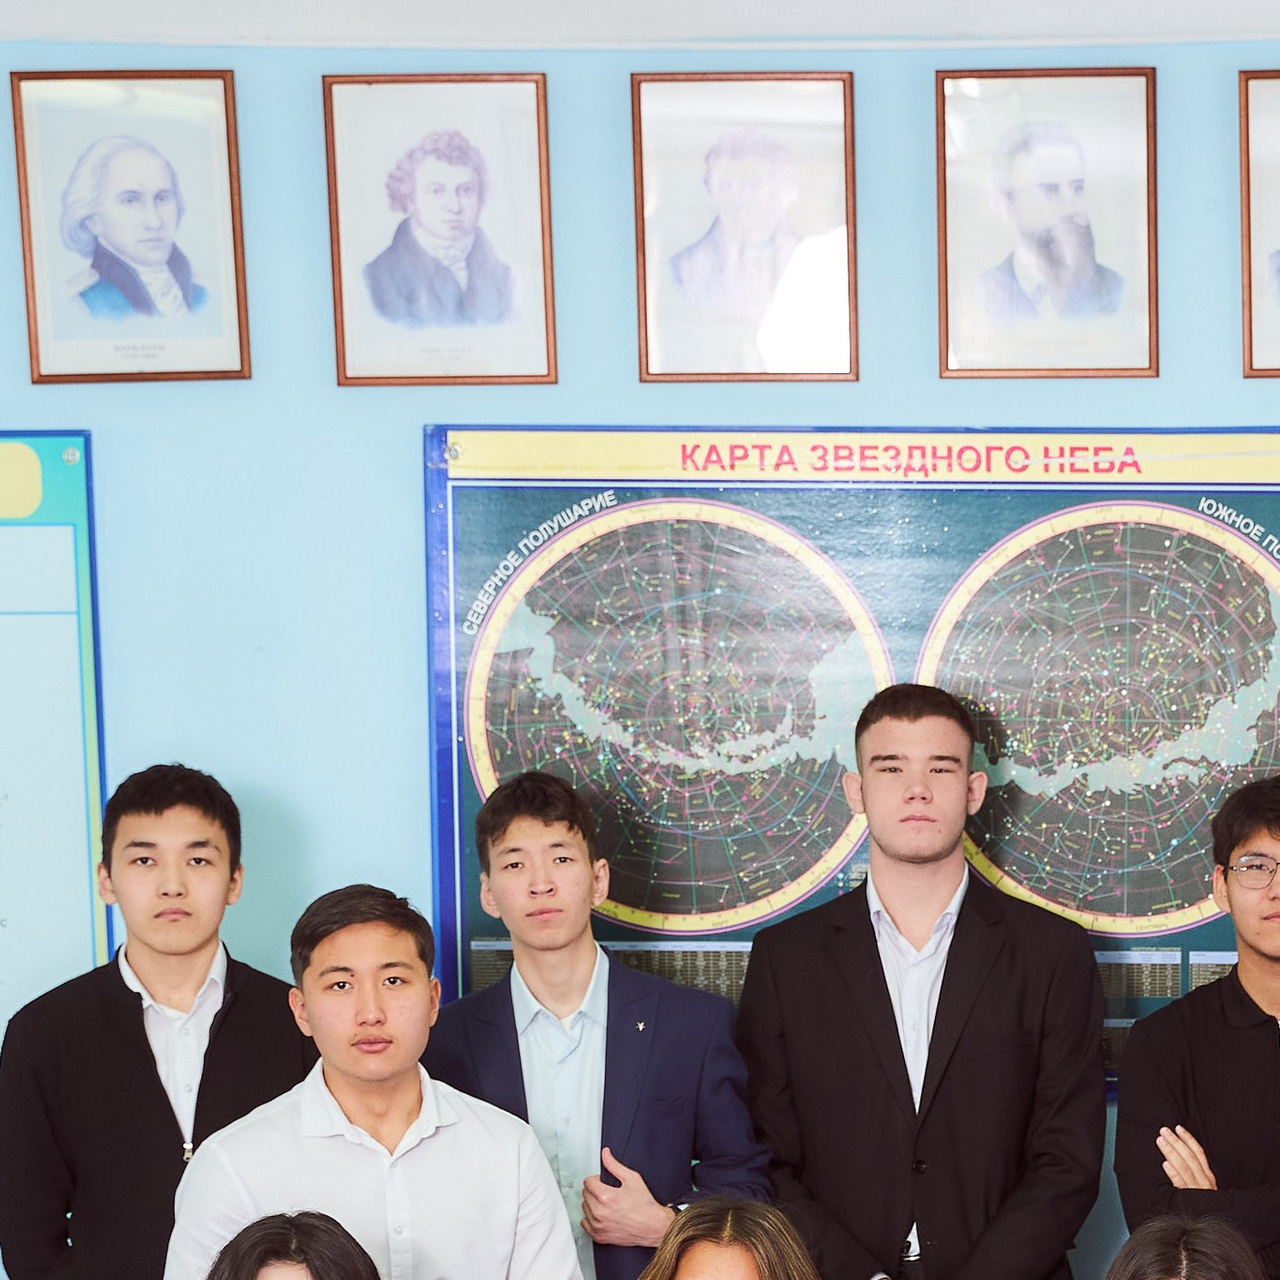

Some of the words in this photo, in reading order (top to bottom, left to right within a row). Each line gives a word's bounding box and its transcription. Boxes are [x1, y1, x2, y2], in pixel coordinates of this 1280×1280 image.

[681, 445, 799, 472] КАРТА
[811, 445, 1029, 477] ЗВЕЗДНОГО
[1043, 446, 1142, 474] НЕБА
[1198, 496, 1265, 541] ЮЖНОЕ
[462, 550, 523, 635] СЕВЕРНОЕ
[518, 490, 618, 556] ПОЛУШАРИЕ
